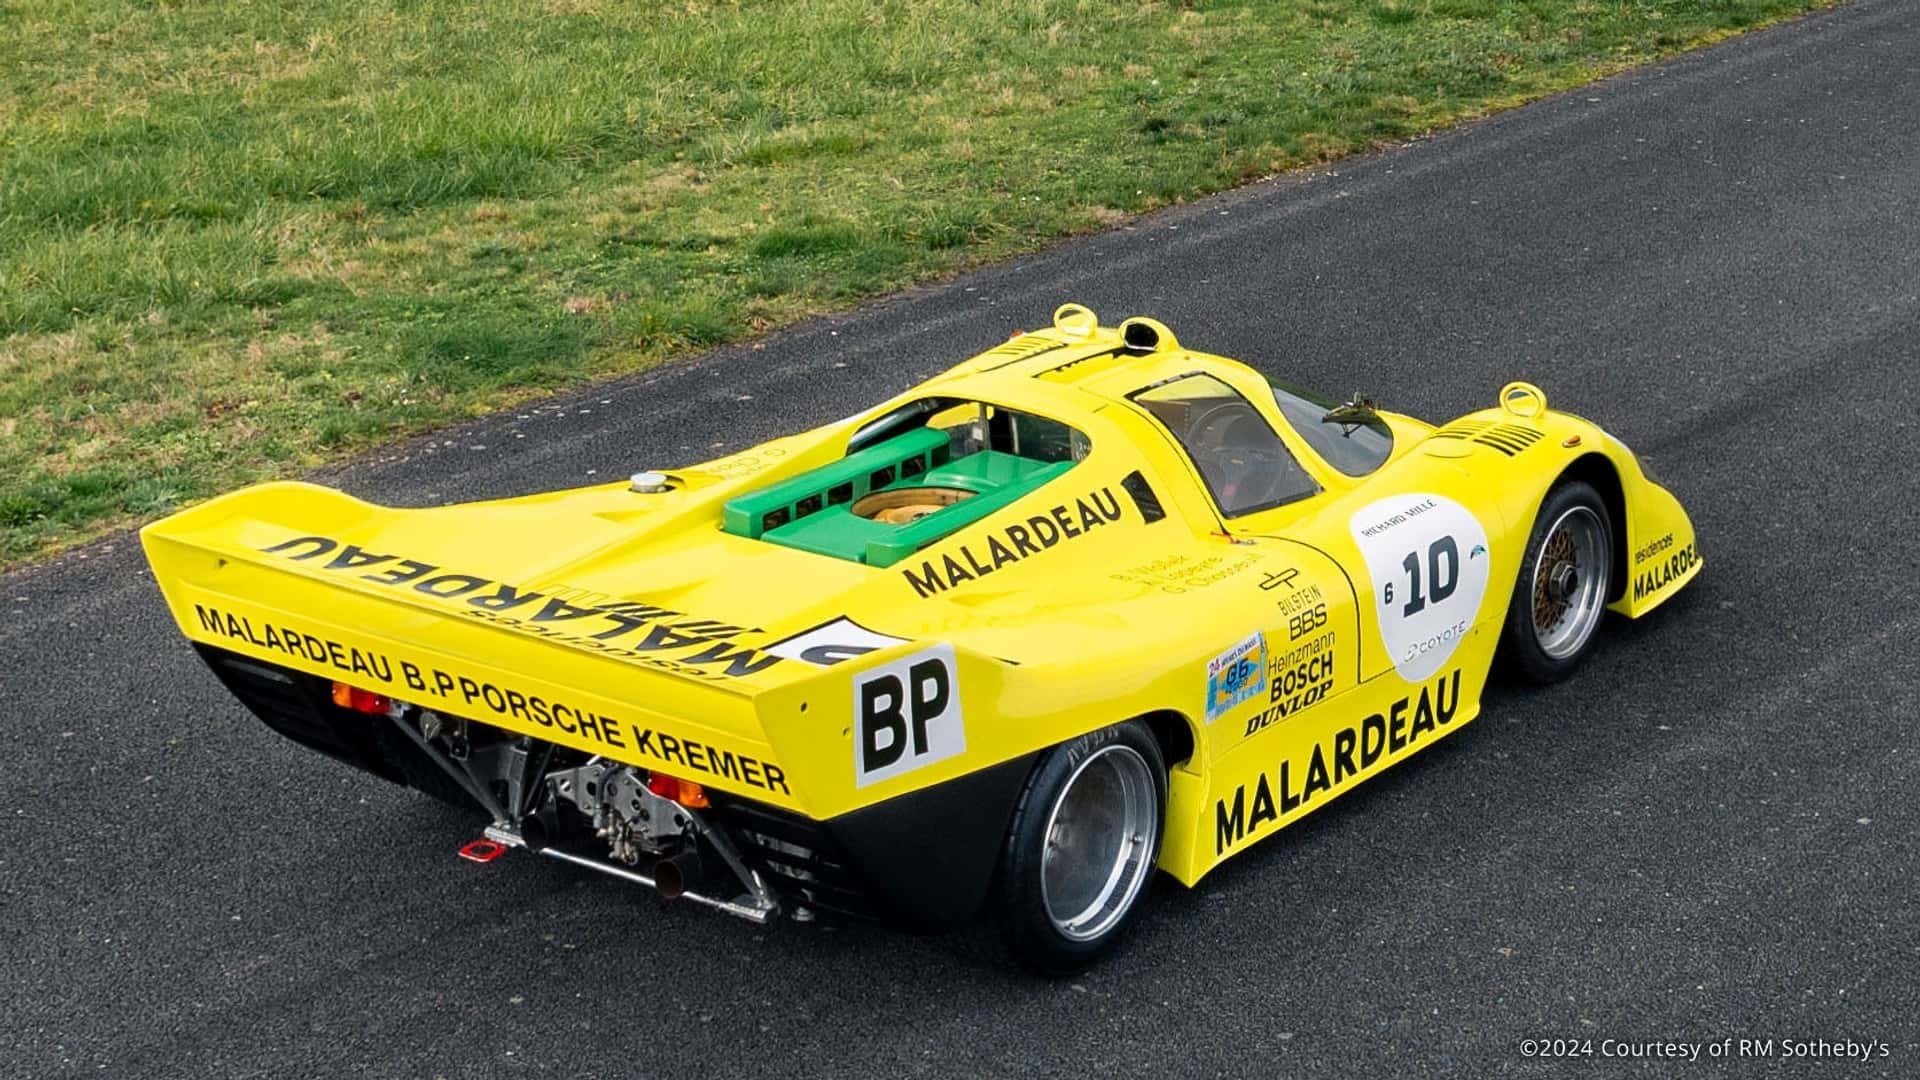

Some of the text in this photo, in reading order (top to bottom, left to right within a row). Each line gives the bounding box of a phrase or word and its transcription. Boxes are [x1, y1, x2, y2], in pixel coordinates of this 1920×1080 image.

[902, 487, 1122, 599] MALARDEAU
[1384, 535, 1459, 618] 6 10
[256, 537, 784, 677] MALARDEAU
[1277, 584, 1322, 617] BILSTEIN
[1289, 603, 1328, 642] BBS
[1268, 631, 1336, 677] Heinzmann
[1419, 620, 1466, 654] COYOTE
[195, 604, 393, 683] MALARDEAU
[459, 677, 625, 749] PORSCHE
[633, 726, 791, 795] KREMER
[1244, 679, 1333, 738] DUNLOP
[1270, 650, 1333, 705] BOSCH
[861, 658, 950, 774] BP
[1216, 668, 1461, 857] MALARDEAU
